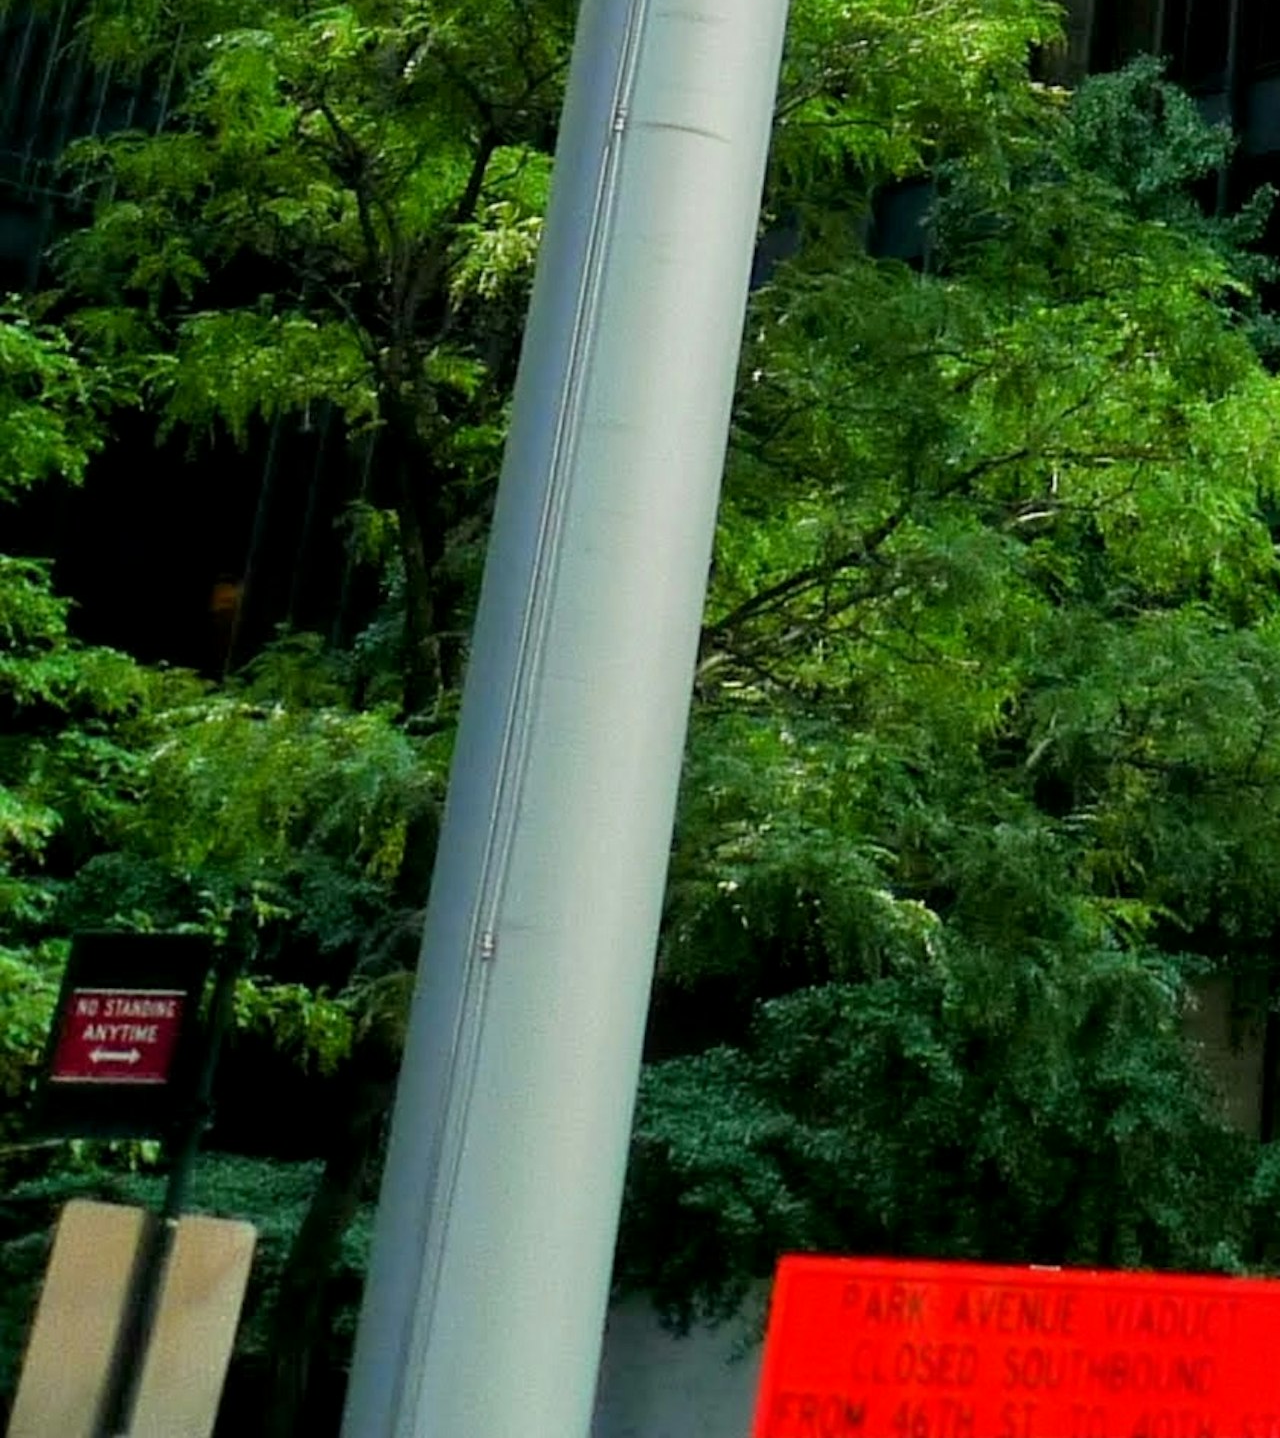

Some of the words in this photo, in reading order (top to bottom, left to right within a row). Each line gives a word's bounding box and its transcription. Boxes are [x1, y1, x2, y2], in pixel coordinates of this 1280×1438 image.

[76, 999, 99, 1017] NO
[103, 999, 176, 1018] STANDING
[82, 1023, 158, 1043] ANYTIME
[841, 1282, 925, 1325] PARK
[953, 1287, 1078, 1335] AVENUE
[1105, 1293, 1241, 1342] VIADUCT
[851, 1339, 978, 1386] CLOSED
[1003, 1347, 1216, 1397] SOUTHBOUND
[771, 1392, 867, 1435] FROM
